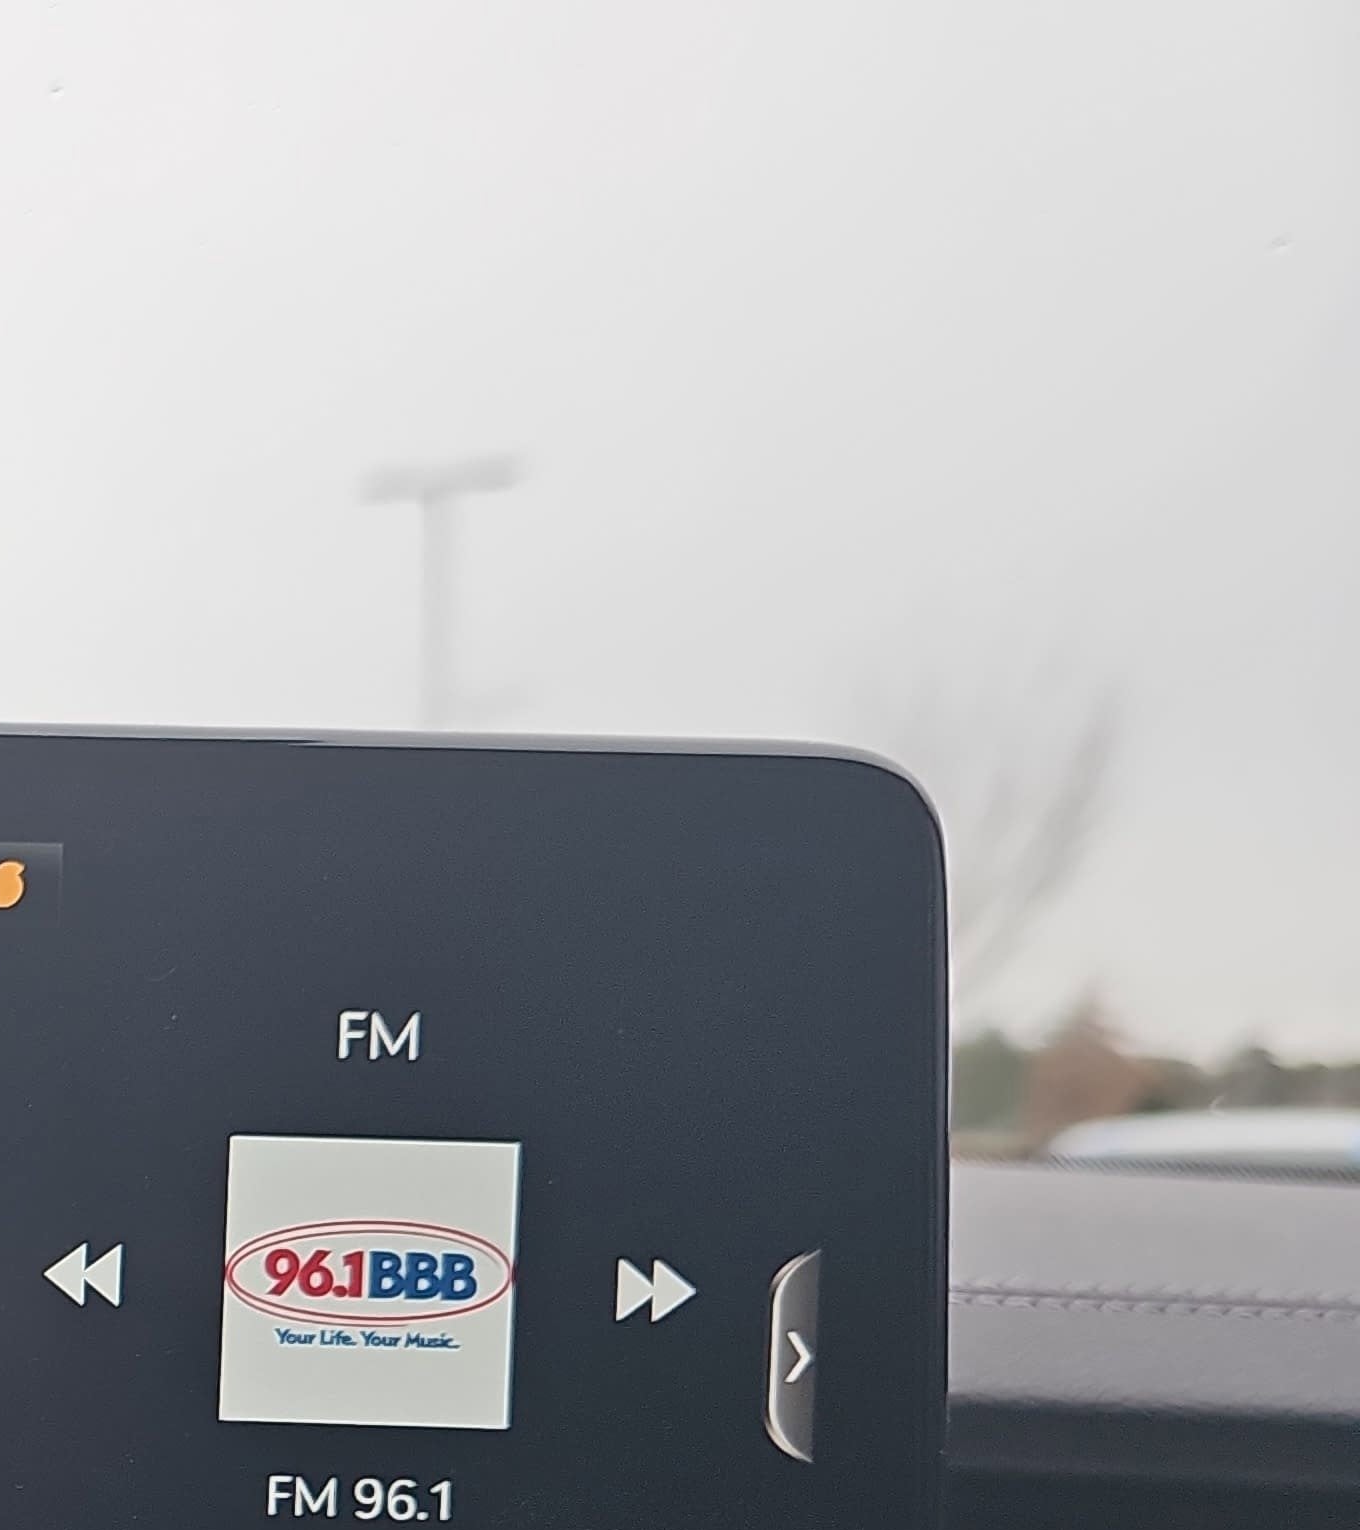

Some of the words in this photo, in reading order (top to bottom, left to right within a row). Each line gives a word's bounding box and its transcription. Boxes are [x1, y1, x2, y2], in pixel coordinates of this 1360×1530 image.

[337, 1011, 422, 1062] FM
[274, 1327, 315, 1346] Your
[360, 1331, 400, 1348] Your
[267, 1475, 338, 1517] FM
[354, 1478, 452, 1521] 96.1
